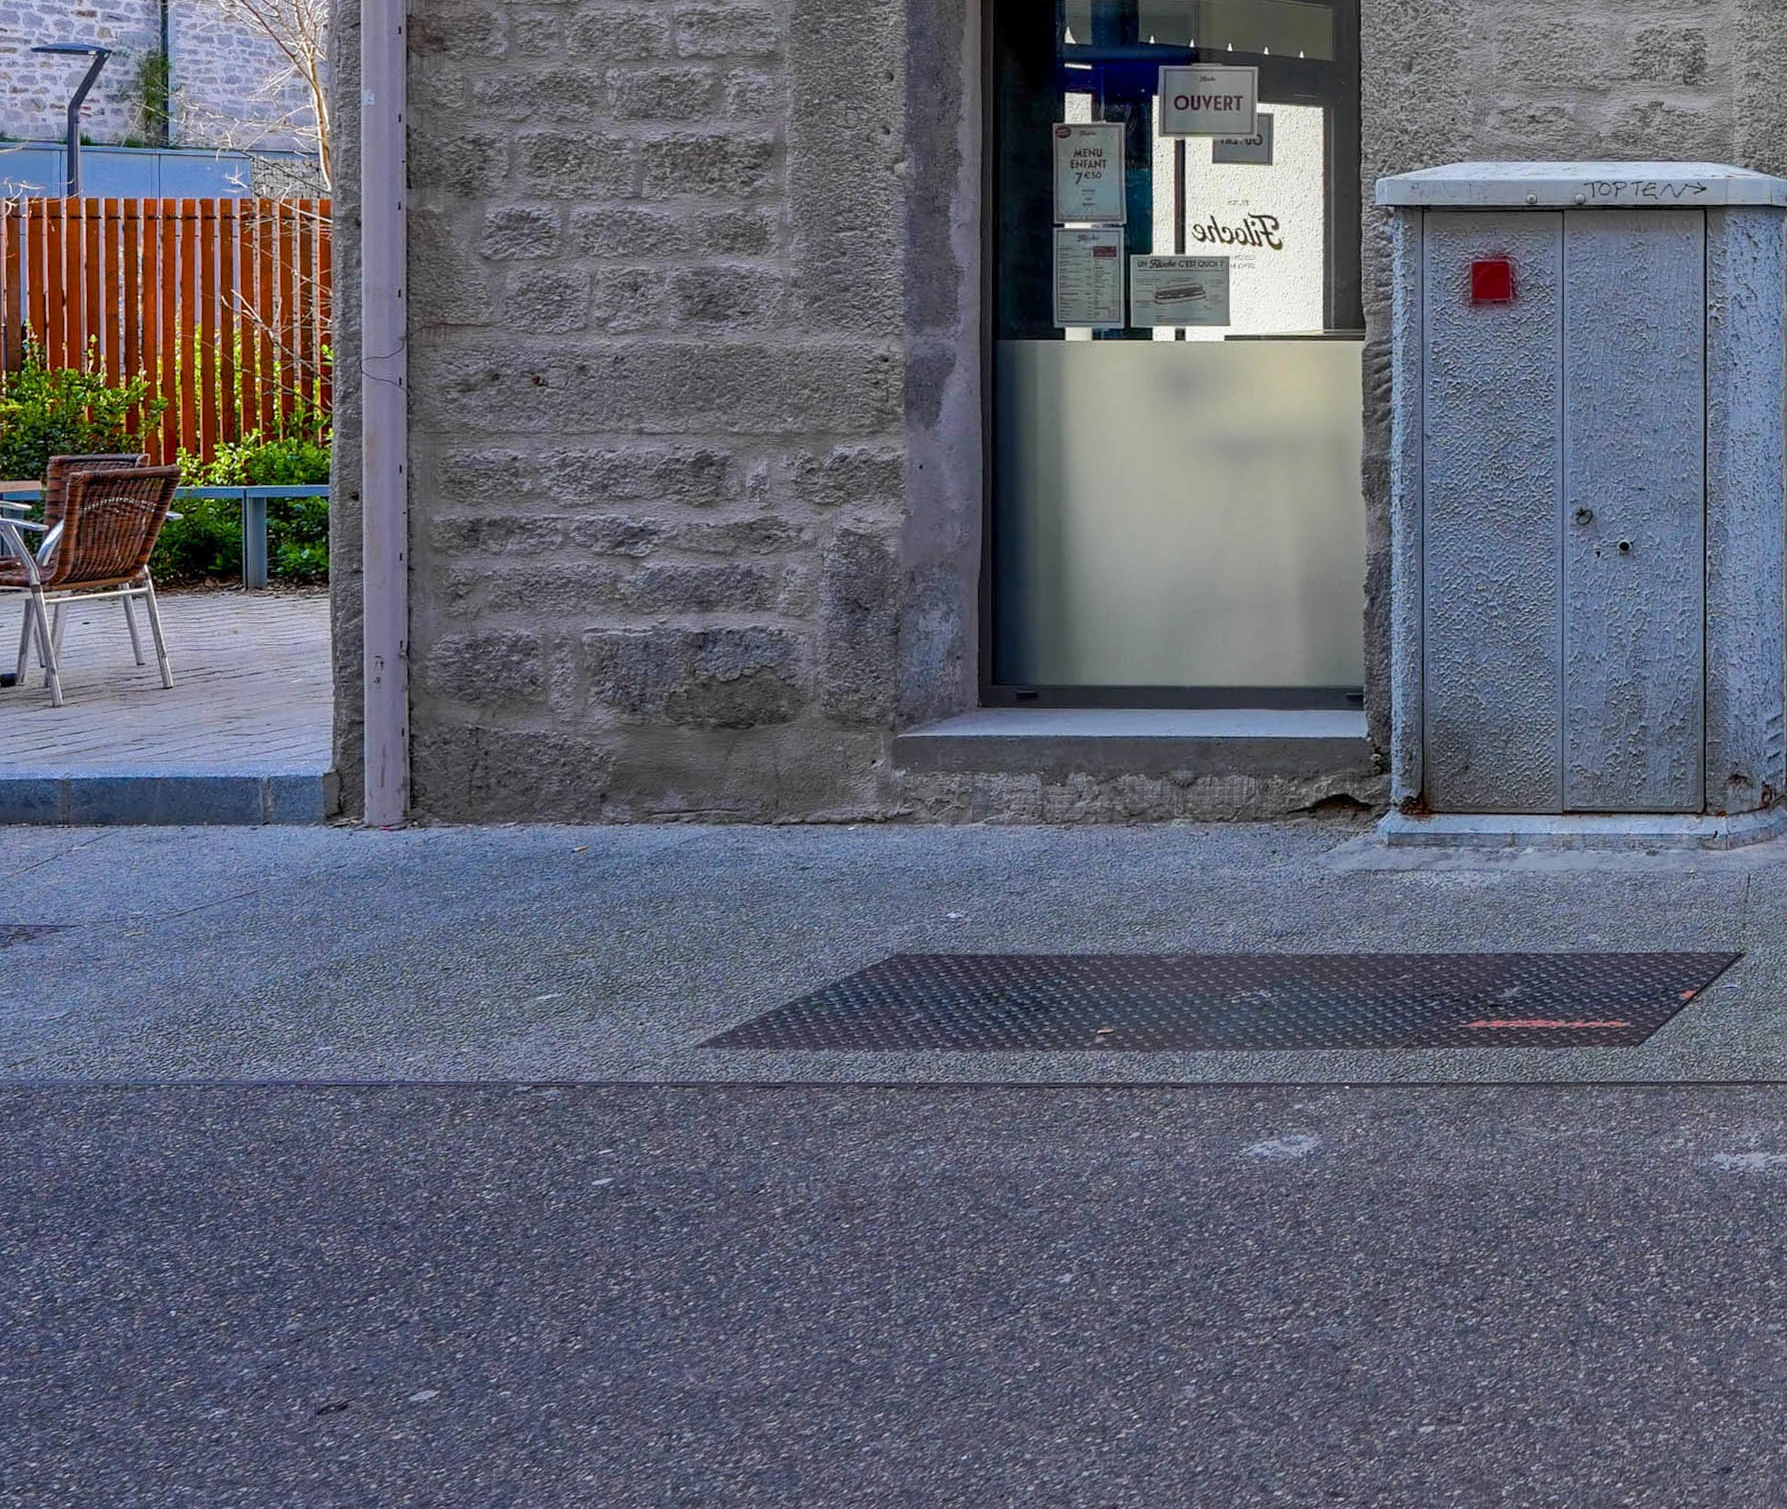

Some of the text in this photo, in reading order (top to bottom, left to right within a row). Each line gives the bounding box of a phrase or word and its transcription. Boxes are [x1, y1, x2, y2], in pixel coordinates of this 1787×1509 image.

[1174, 95, 1243, 111] OUVERT
[1073, 148, 1103, 157] MENU
[1070, 159, 1107, 169] ENFANT
